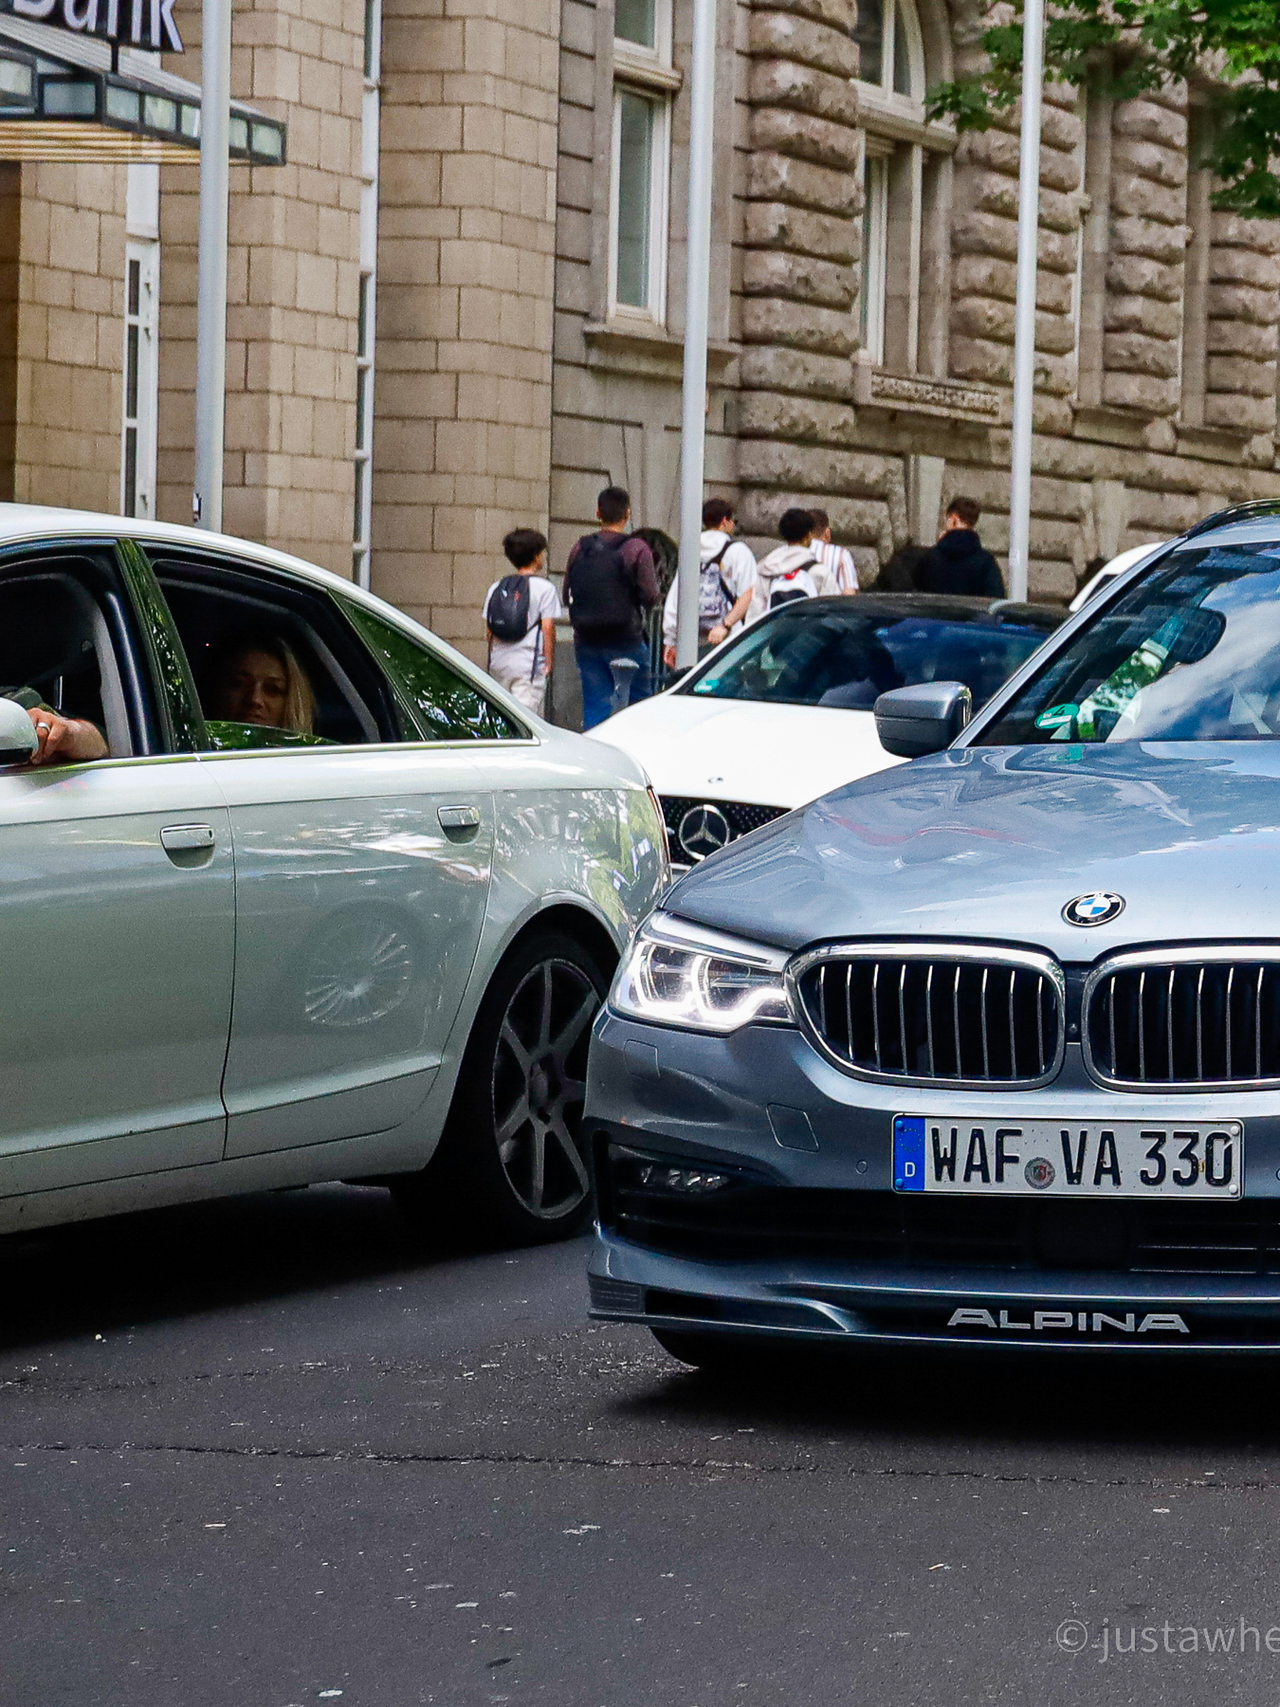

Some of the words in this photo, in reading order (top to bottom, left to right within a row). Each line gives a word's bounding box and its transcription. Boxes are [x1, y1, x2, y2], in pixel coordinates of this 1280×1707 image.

[904, 1161, 917, 1178] D
[930, 1126, 1024, 1184] WAF
[1060, 1129, 1122, 1187] VA
[1138, 1130, 1234, 1188] 330
[946, 1307, 1191, 1334] ALPINA
